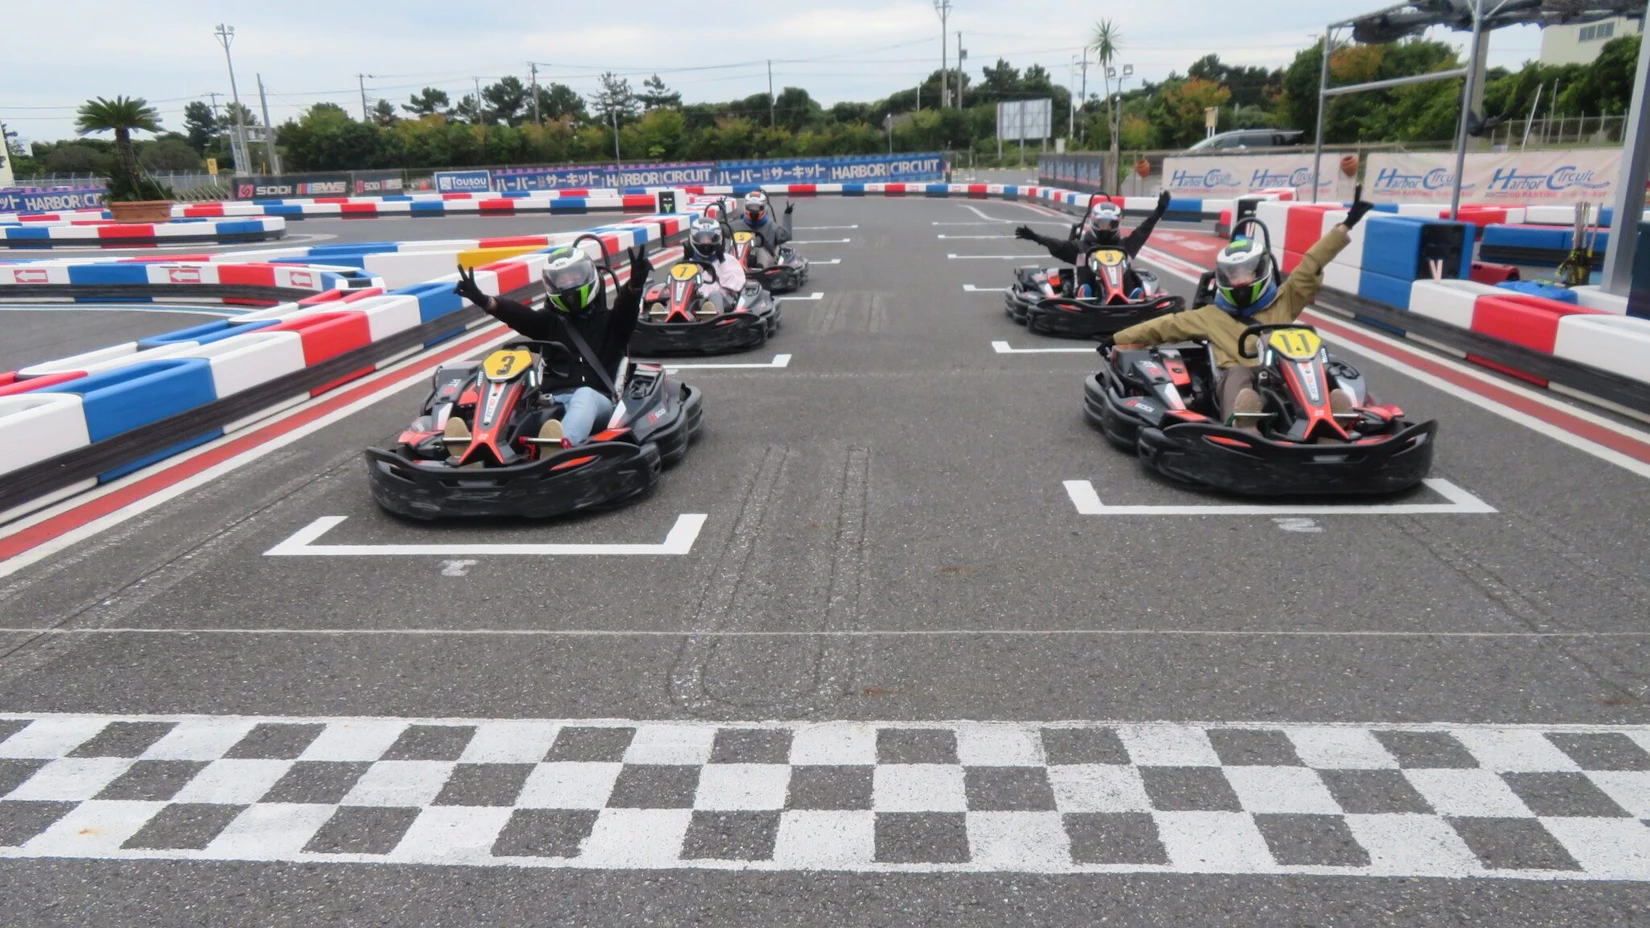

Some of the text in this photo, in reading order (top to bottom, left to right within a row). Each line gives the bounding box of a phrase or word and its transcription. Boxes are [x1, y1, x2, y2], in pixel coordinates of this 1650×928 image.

[663, 168, 712, 184] CIRCUIT
[832, 159, 939, 180] HARBOR CIRCUIT
[1487, 168, 1546, 190] Harbor
[256, 185, 292, 195] SODI
[25, 195, 81, 211] HARBOR
[680, 266, 688, 278] 7
[1278, 333, 1312, 354] 11
[496, 355, 515, 375] 3
